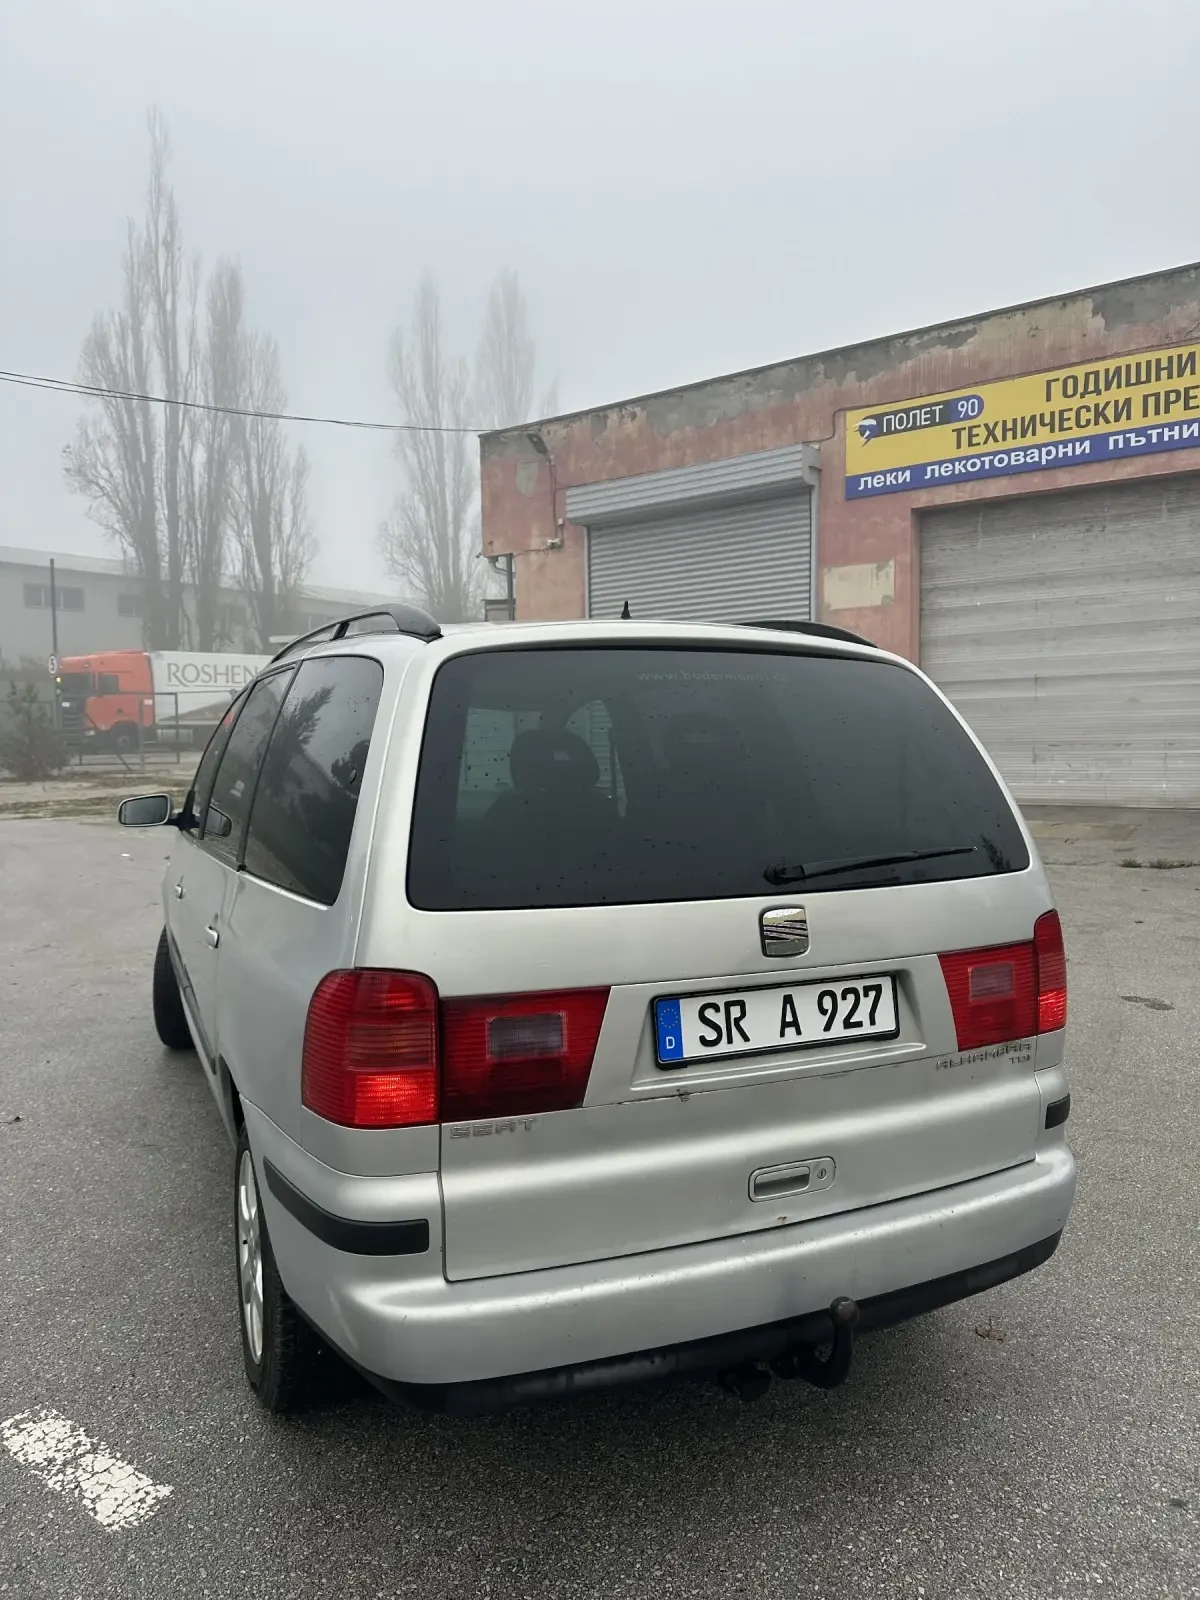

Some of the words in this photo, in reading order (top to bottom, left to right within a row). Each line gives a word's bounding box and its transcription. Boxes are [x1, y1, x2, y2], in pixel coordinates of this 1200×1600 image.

[1045, 351, 1196, 402] ГОДИШНИ
[883, 405, 943, 433] ПОЛЕТ
[957, 399, 978, 418] 90
[952, 396, 1132, 450] ТЕХНИЧЕСКИ
[858, 470, 911, 491] леки
[924, 439, 1090, 480] лекотоварни
[1108, 422, 1199, 450] пътни
[167, 663, 258, 687] ROSHEN
[698, 1000, 751, 1048] SR
[779, 994, 802, 1038] A
[817, 984, 883, 1032] 927
[665, 1036, 675, 1049] D
[936, 1041, 1032, 1070] ALHAMBRA
[450, 1118, 537, 1139] SEAT
